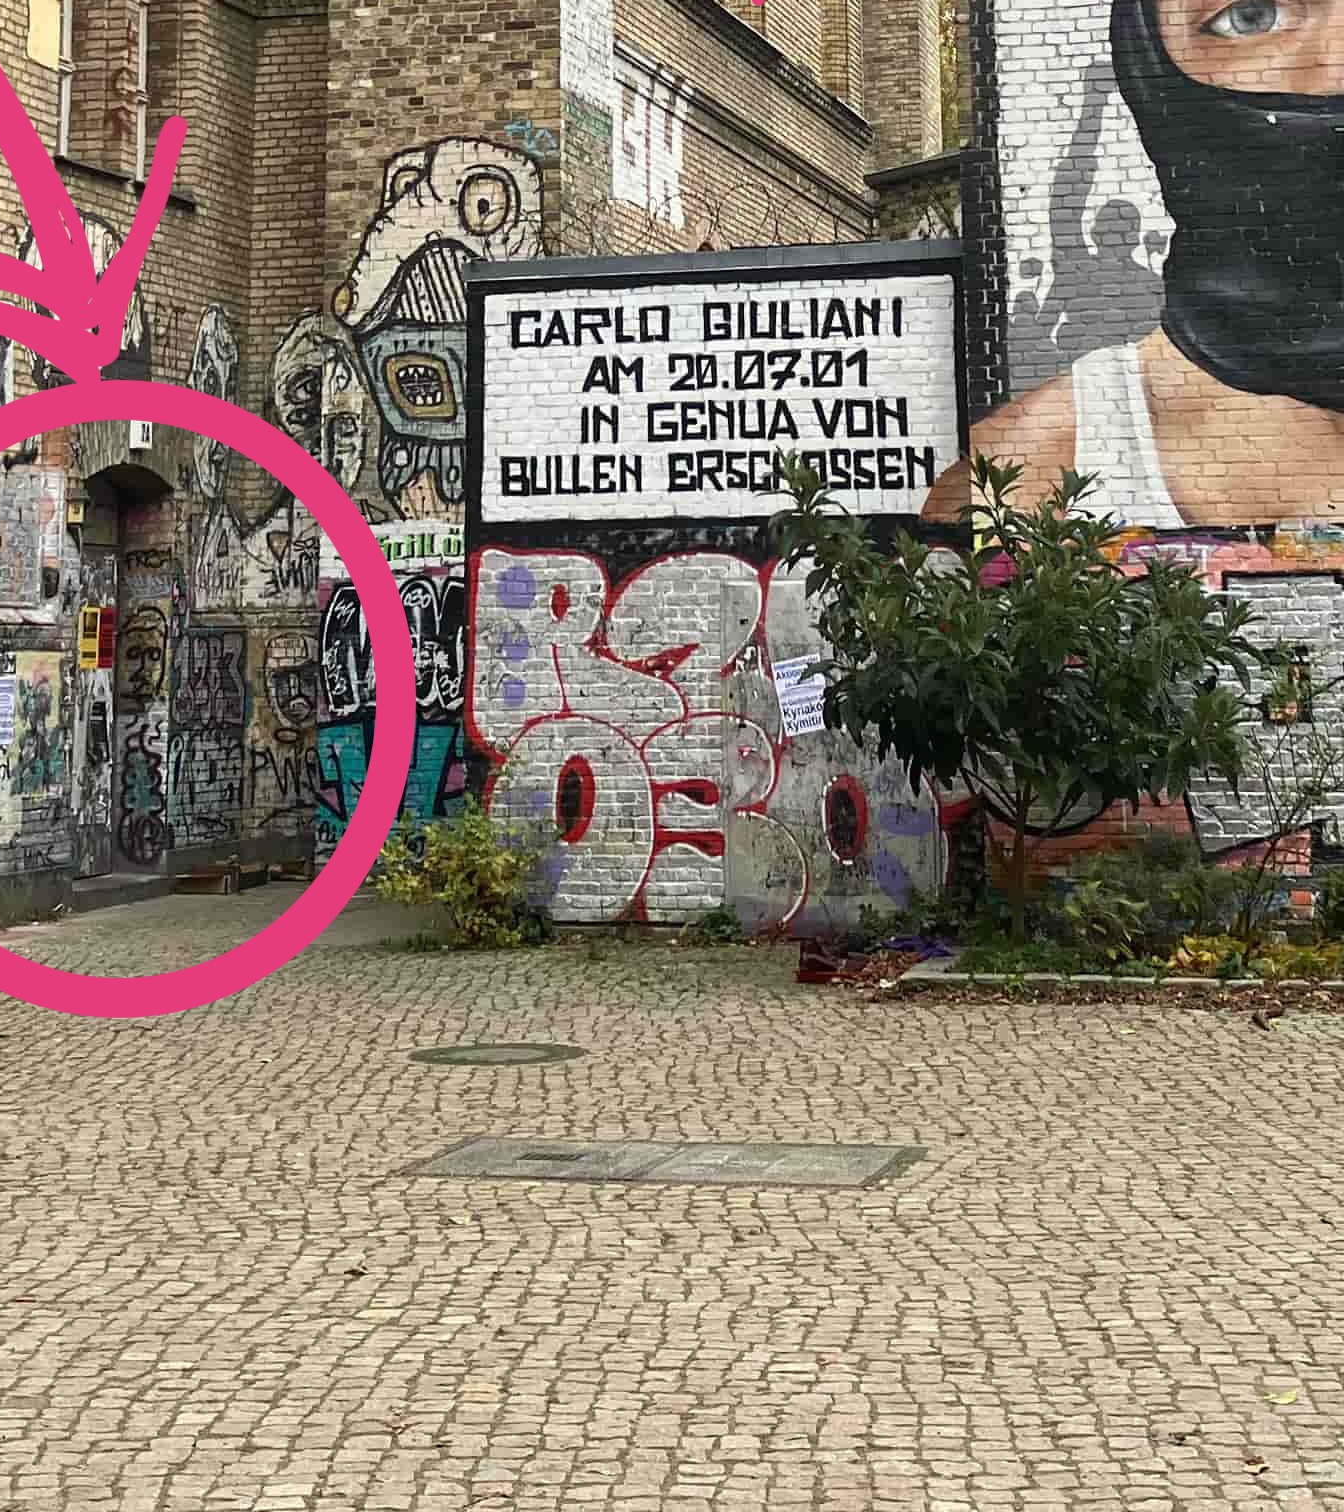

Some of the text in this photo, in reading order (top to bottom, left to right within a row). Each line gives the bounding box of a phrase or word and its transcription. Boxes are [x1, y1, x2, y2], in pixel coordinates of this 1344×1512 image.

[510, 296, 904, 349] CARLO GIULIANI
[581, 348, 869, 395] AM 20.07.01
[581, 396, 909, 444] IN GENUA VON
[500, 453, 643, 498] BULLEN
[783, 701, 824, 721] Kyriako
